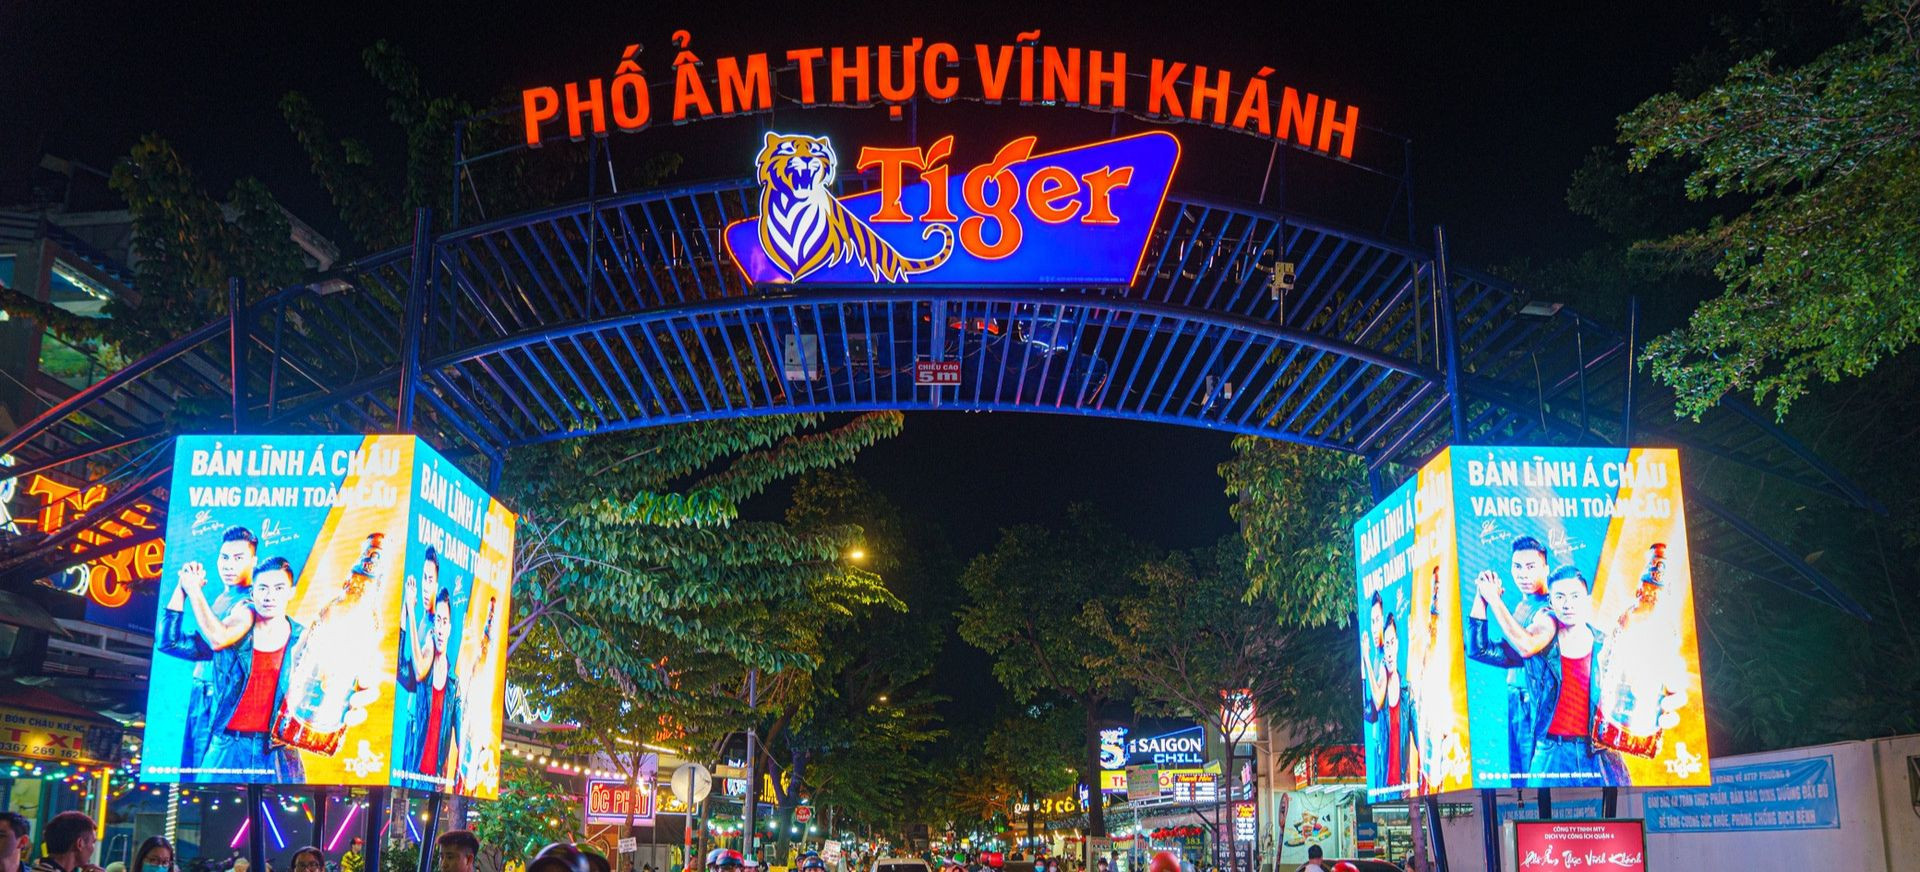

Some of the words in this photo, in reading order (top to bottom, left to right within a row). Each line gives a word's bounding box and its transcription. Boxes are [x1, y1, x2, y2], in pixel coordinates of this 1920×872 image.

[522, 43, 650, 146] PHỐ
[671, 29, 773, 123] ẨM
[786, 37, 960, 119] THỰC
[975, 29, 1127, 110] VĨNH
[1148, 58, 1360, 162] KHÁNH
[856, 135, 1134, 260] Tiger
[919, 371, 934, 382] 5
[937, 372, 958, 381] m
[191, 441, 243, 476] BẢN
[247, 444, 304, 476] LĨNH
[308, 443, 327, 476] Á
[1467, 452, 1518, 487] BẢN
[1523, 456, 1578, 487] LĨNH
[1582, 456, 1600, 488] Á
[189, 486, 242, 507] VANG
[244, 486, 299, 507] DANH
[420, 459, 448, 513] BẢN
[448, 480, 474, 532] LĨNH
[1470, 496, 1523, 517] VANG
[1526, 497, 1578, 518] DANH
[418, 513, 444, 555] VANG
[444, 532, 469, 572] DANH
[1360, 520, 1380, 565] BẢN
[33, 746, 55, 755] 269
[60, 749, 79, 758] 162
[1138, 738, 1202, 752] SAIGON
[1153, 753, 1203, 763] CHILL
[590, 784, 610, 813] ỐC
